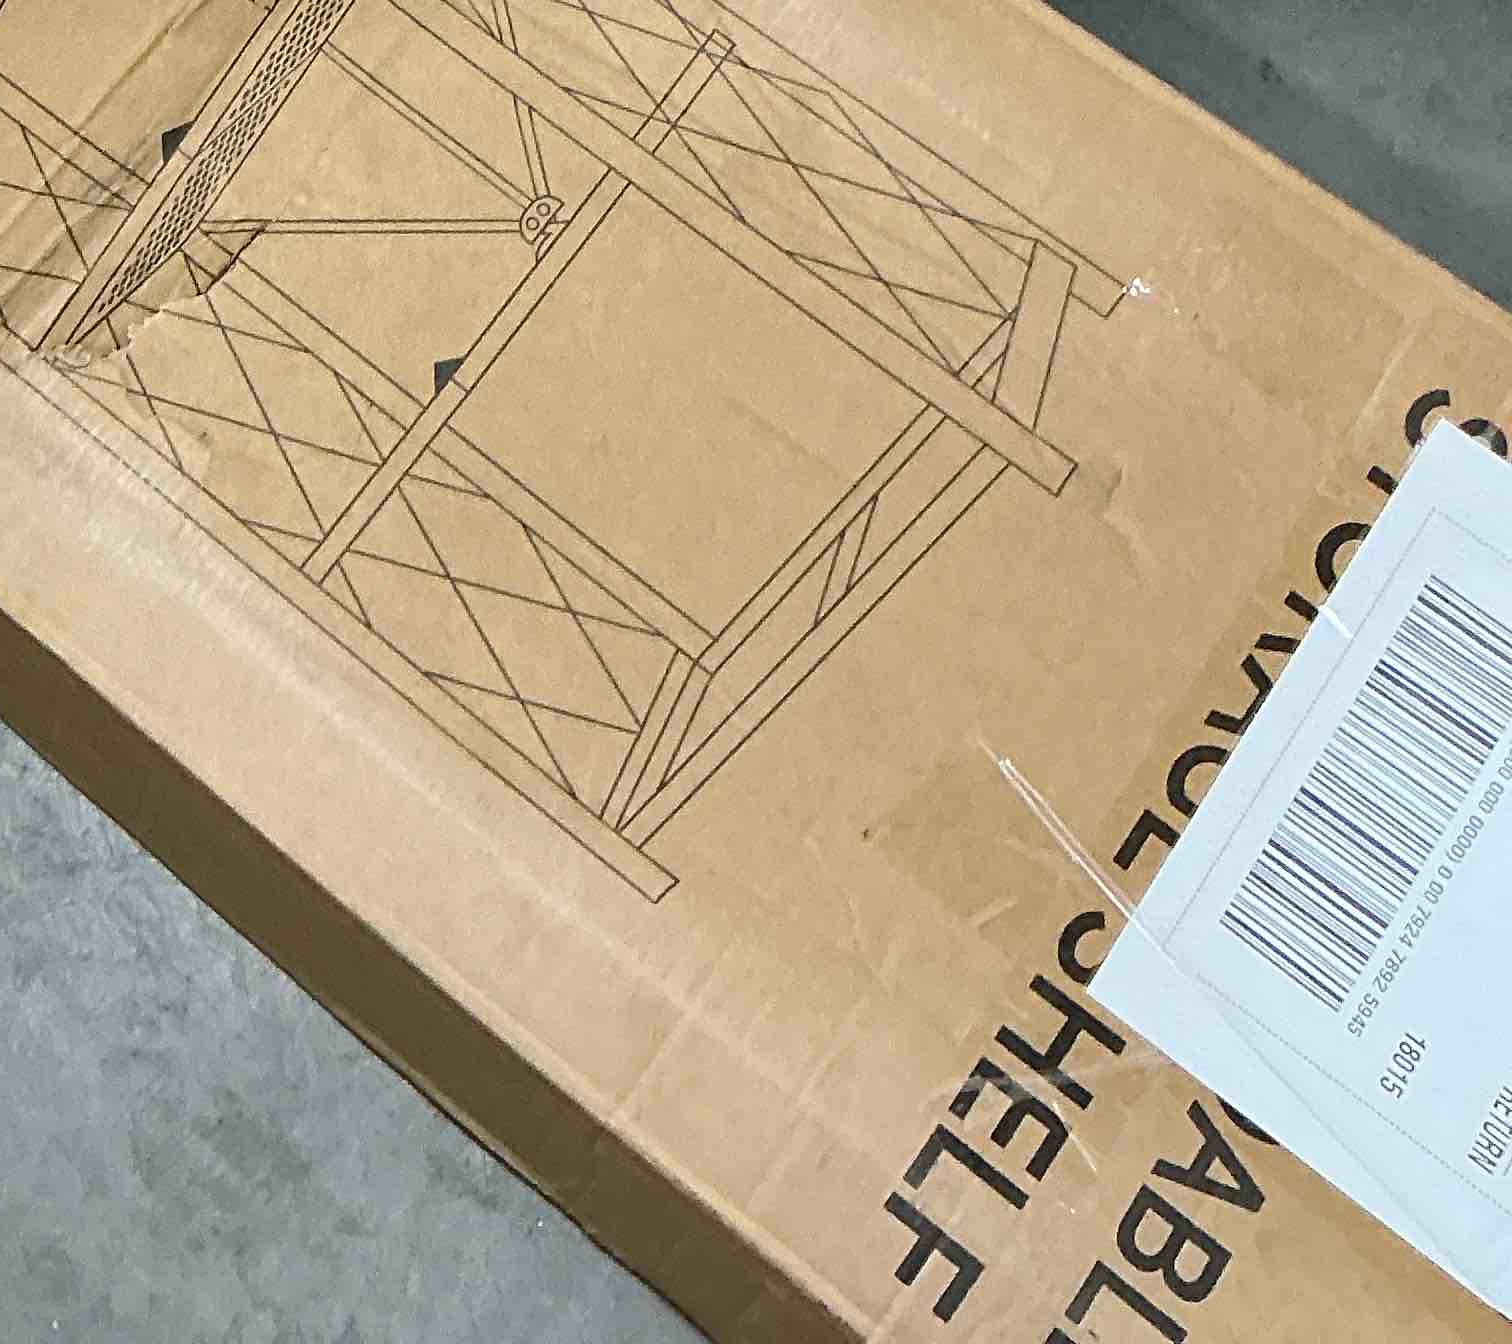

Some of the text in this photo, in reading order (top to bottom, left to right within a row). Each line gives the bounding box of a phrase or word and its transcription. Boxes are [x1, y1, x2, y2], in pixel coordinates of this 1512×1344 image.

[1399, 905, 1432, 948] 7924
[1372, 949, 1407, 993] 7892
[1347, 992, 1379, 1038] 5945
[1379, 1032, 1427, 1099] 18015
